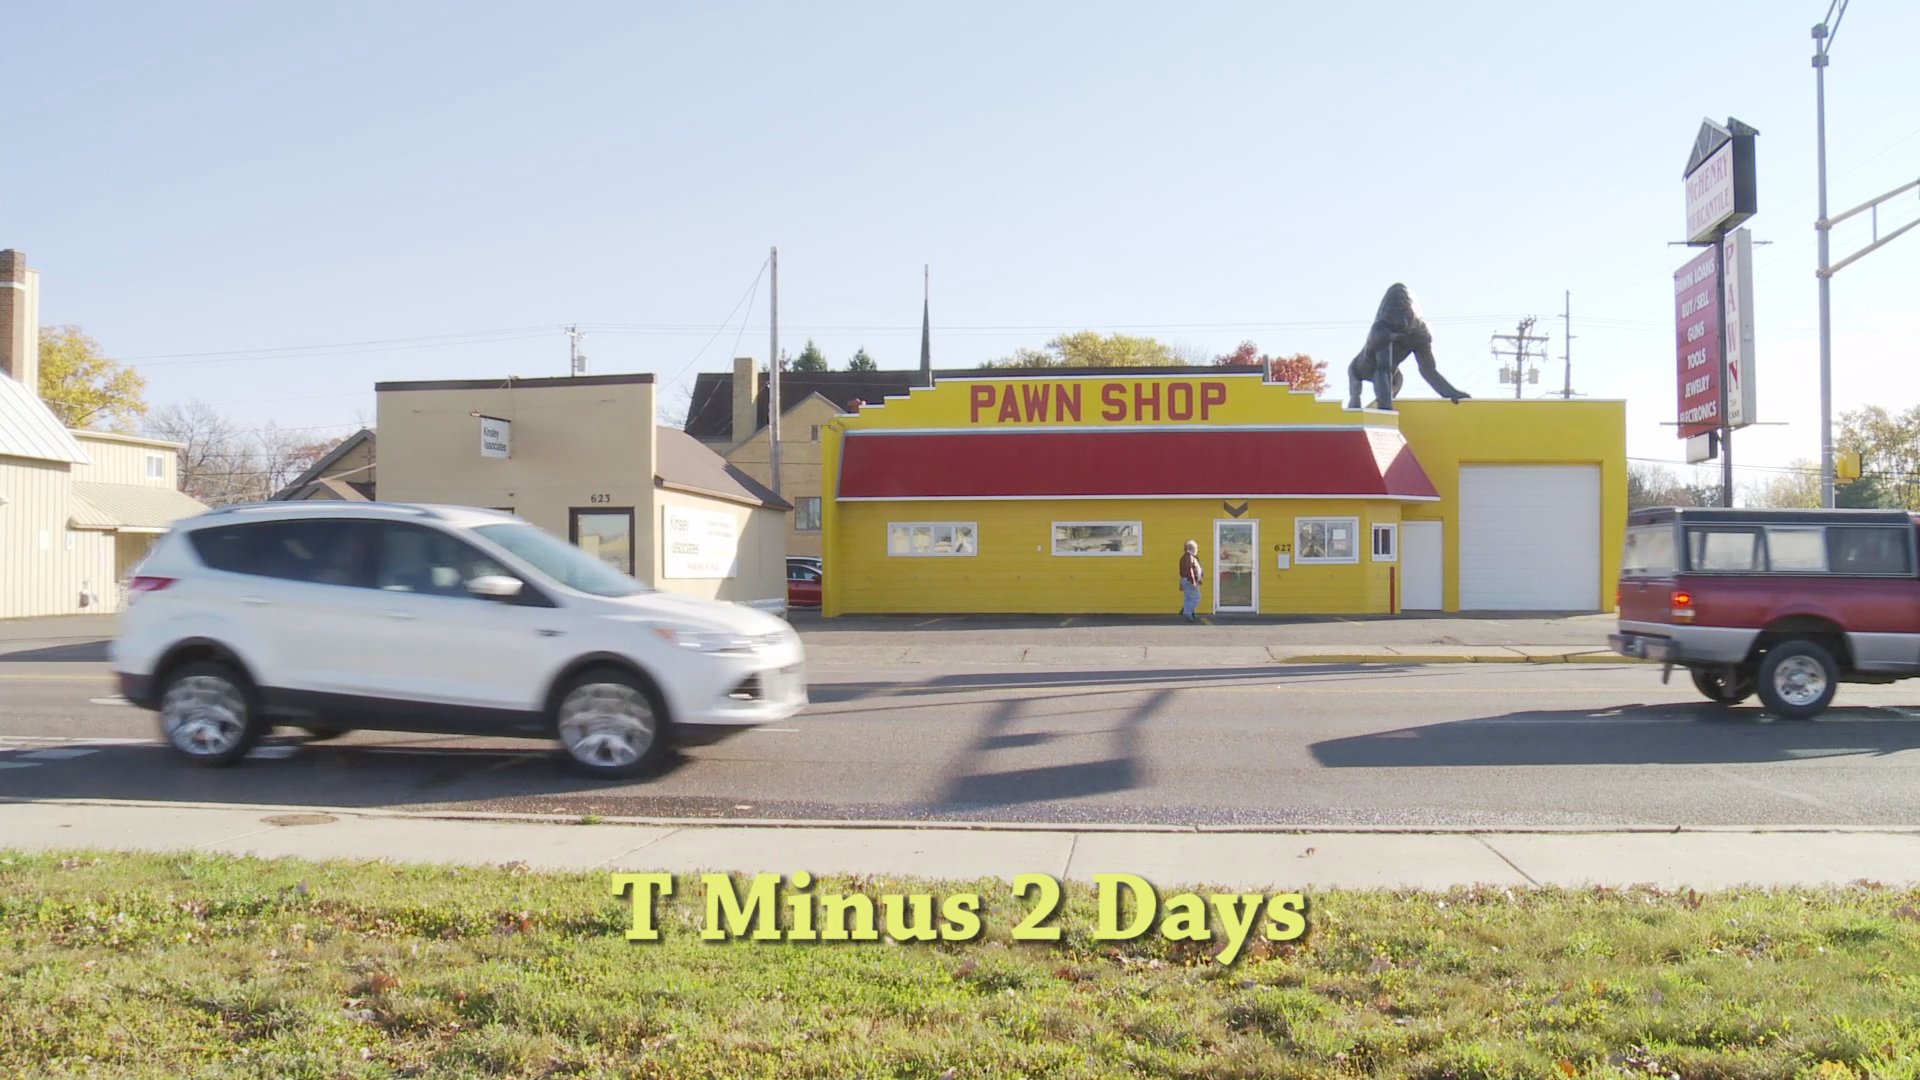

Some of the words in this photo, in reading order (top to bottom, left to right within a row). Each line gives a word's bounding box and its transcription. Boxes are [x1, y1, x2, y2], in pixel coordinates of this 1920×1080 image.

[1694, 257, 1716, 284] LOANS
[1725, 243, 1739, 393] PAWN
[1687, 321, 1705, 343] GUNS
[1687, 348, 1706, 371] TOOLS
[1684, 374, 1710, 399] JEWELRY
[970, 383, 1081, 423] PAWN
[1101, 382, 1227, 422] SHOP
[1680, 400, 1717, 423] ELECTRONICS
[590, 493, 611, 504] 623
[670, 541, 700, 555] ssociates
[1274, 543, 1292, 552] 627
